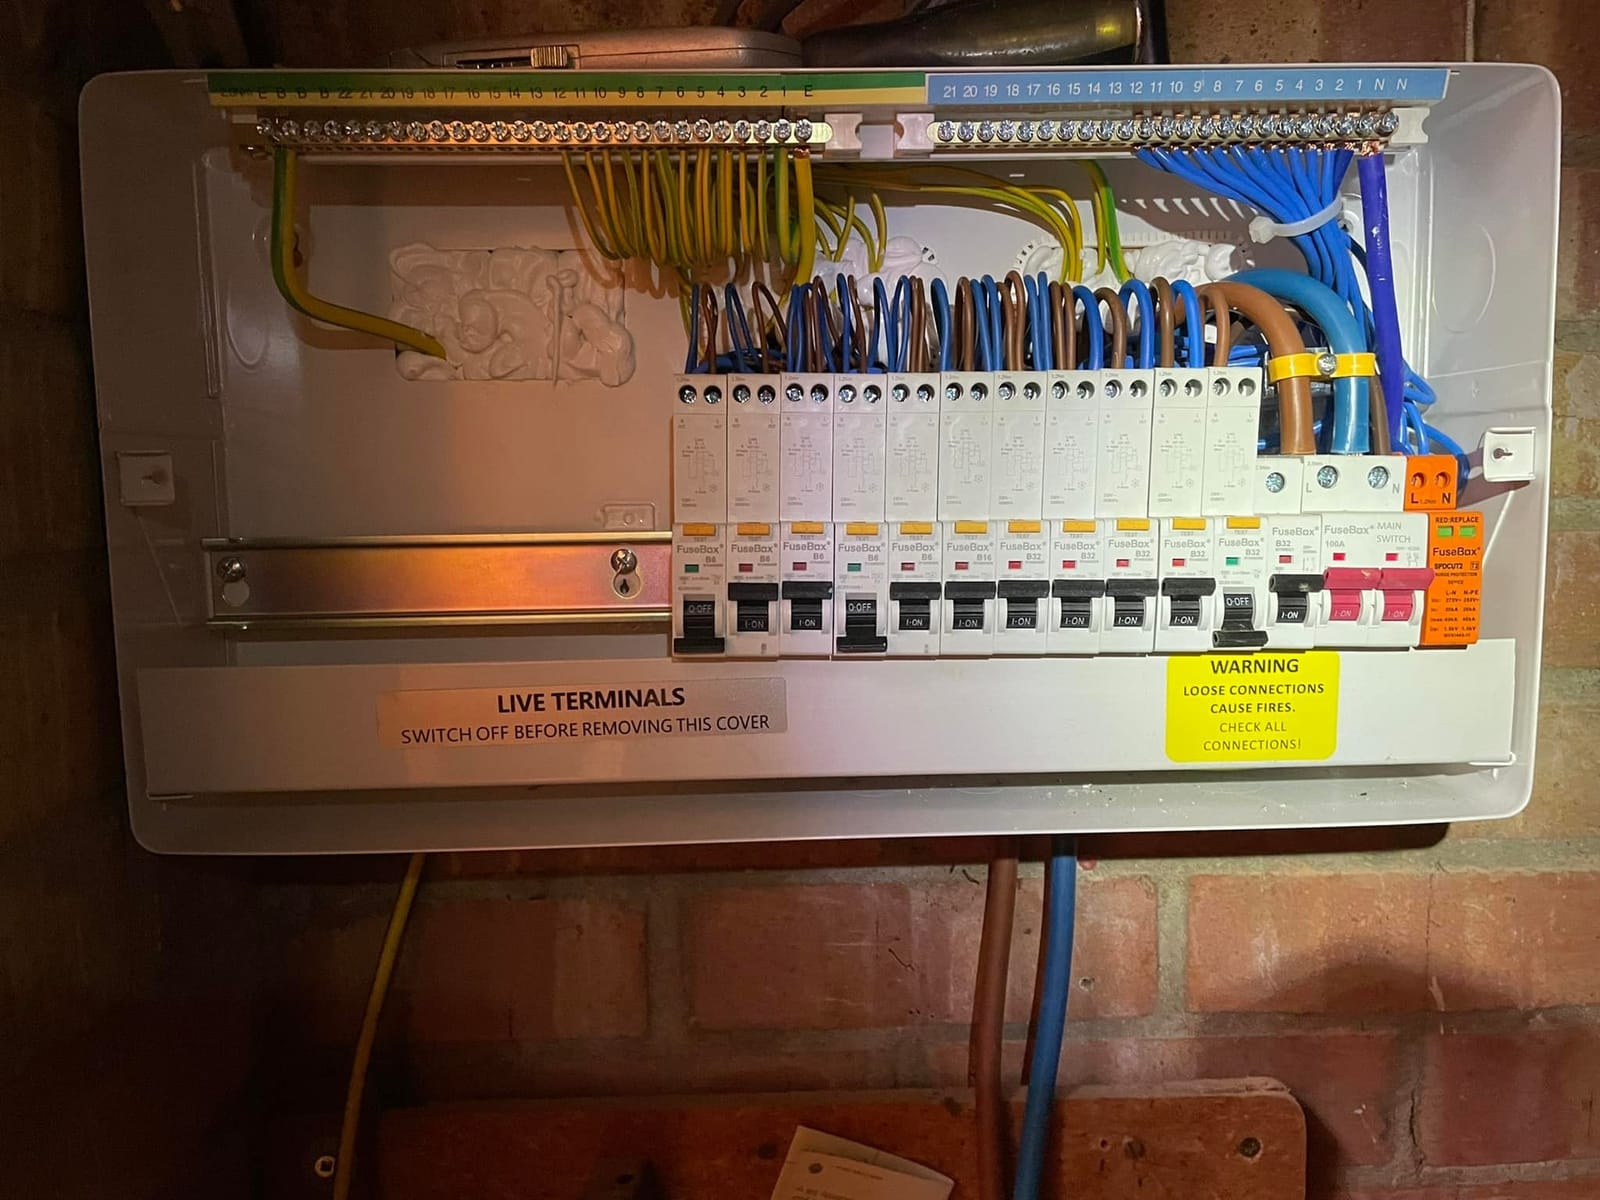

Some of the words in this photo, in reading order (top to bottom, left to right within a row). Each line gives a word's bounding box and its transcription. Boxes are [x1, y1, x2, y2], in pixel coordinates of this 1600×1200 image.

[338, 87, 352, 99] 22
[360, 87, 372, 99] 21
[381, 87, 395, 99] 20
[401, 87, 414, 99] 19
[423, 87, 436, 99] 18
[443, 87, 455, 99] 17
[467, 87, 480, 99] 16
[488, 87, 500, 99] 15
[509, 87, 520, 99] 14
[530, 87, 543, 99] 13
[553, 87, 567, 99] 12
[575, 87, 586, 99] 11
[595, 87, 607, 99] 10
[618, 86, 626, 98] 9
[636, 86, 645, 98] 8
[656, 86, 664, 98] 7
[676, 86, 685, 98] 6
[697, 86, 705, 98] 5
[717, 86, 725, 97] 4
[738, 86, 746, 97] 3
[759, 86, 768, 97] 2
[804, 85, 813, 97] E
[943, 86, 956, 98] 21
[963, 85, 977, 98] 20
[984, 85, 997, 97] 19
[1006, 84, 1019, 96] 18
[1027, 83, 1040, 96] 17
[1047, 83, 1060, 96] 16
[1067, 83, 1080, 95] 15
[1088, 82, 1100, 95] 14
[1108, 82, 1122, 94] 13
[1129, 82, 1143, 94] 12
[1150, 81, 1162, 93] 11
[1169, 81, 1183, 93] 10
[1194, 81, 1201, 93] 9
[1213, 80, 1222, 92] 8
[1235, 80, 1244, 92] 7
[1254, 80, 1263, 92] 6
[1275, 80, 1284, 92] 5
[1295, 79, 1303, 91] 4
[1315, 79, 1324, 91] 3
[1335, 79, 1344, 91] 2
[1374, 78, 1385, 90] N
[1396, 78, 1408, 90] N
[1306, 483, 1312, 493] L
[1392, 484, 1399, 494] N
[1411, 492, 1419, 504] L
[1442, 492, 1451, 504] N
[1377, 522, 1402, 530] MAIN
[1325, 540, 1345, 548] 100A
[1376, 535, 1411, 544] SWITCH
[1211, 658, 1299, 674] WARNING
[1184, 686, 1225, 696] LOOSE
[1229, 683, 1325, 695] CONNECTIONS
[498, 694, 546, 713] LIVE
[551, 687, 686, 709] TERMINALS
[1210, 703, 1253, 713] CAUSE
[1257, 702, 1296, 713] FIRES.
[401, 728, 472, 744] SWITCH
[476, 725, 509, 740] OFF
[514, 722, 579, 739] BEFORE
[583, 718, 673, 736] REMOVING
[676, 716, 712, 732] THIS
[716, 714, 770, 731] COVER
[1219, 722, 1260, 733] CHECK
[1265, 721, 1287, 732] ALL
[1203, 738, 1301, 751] CONNECTIONS!
